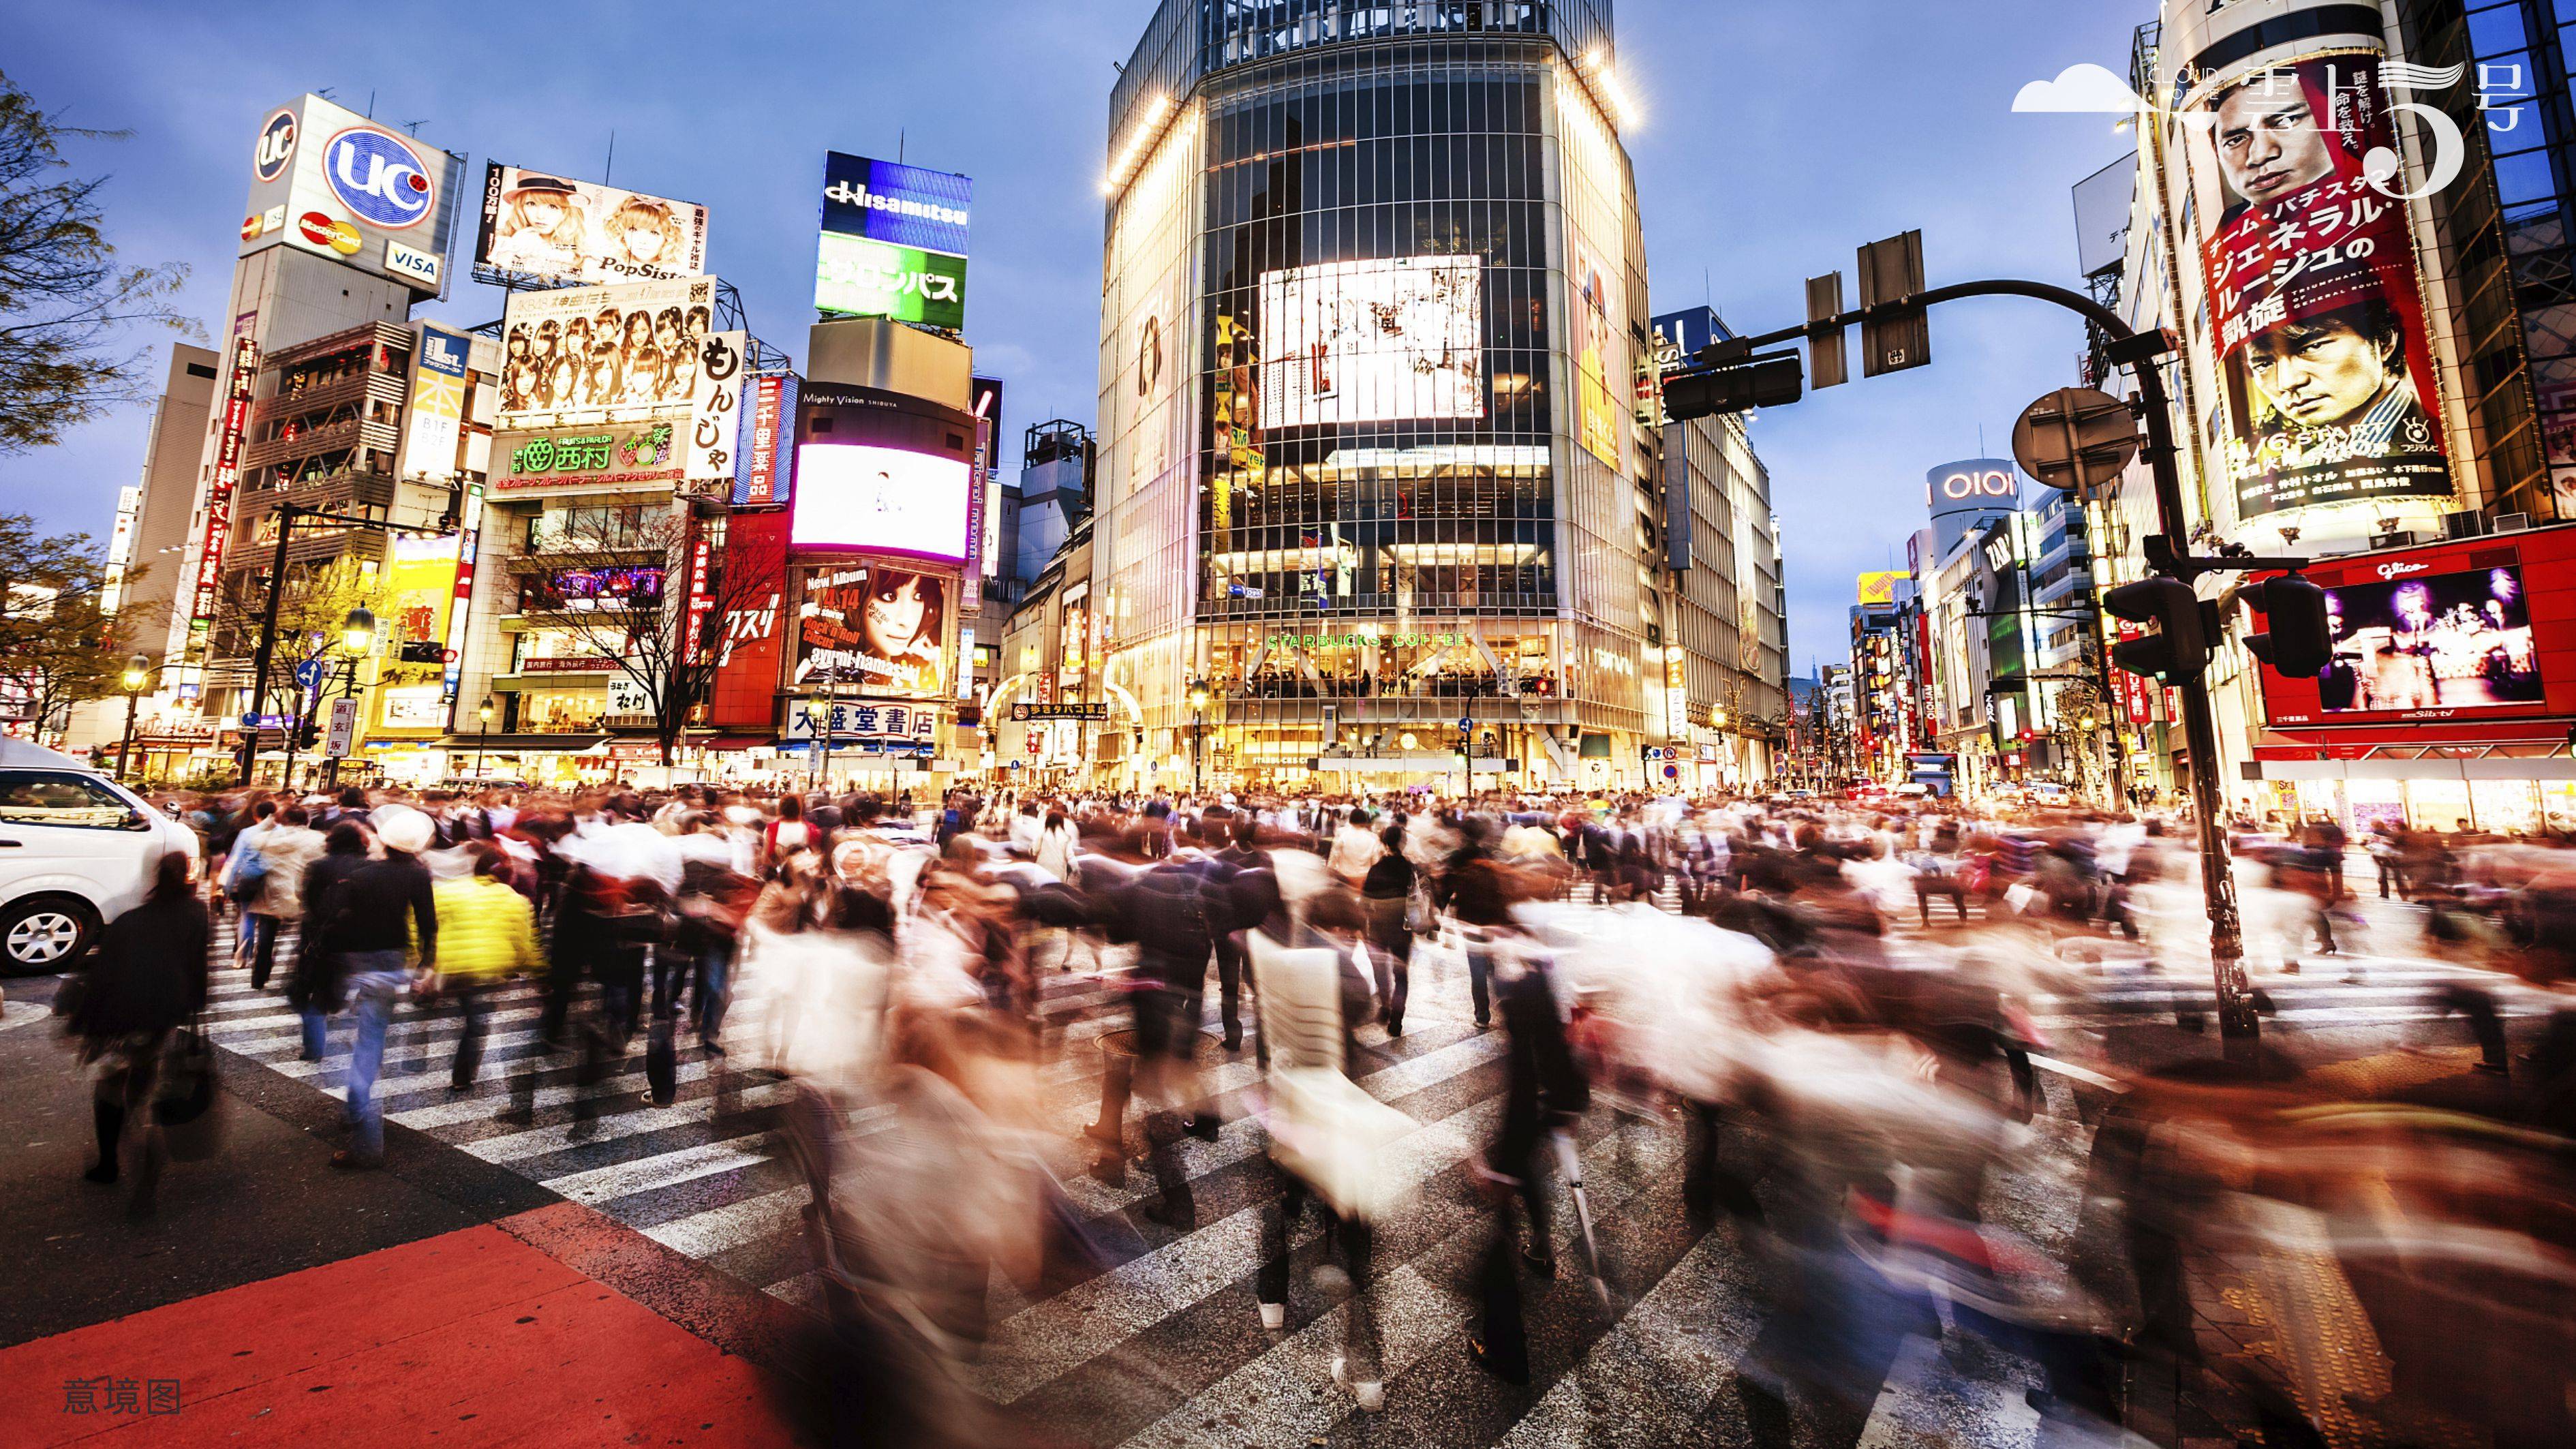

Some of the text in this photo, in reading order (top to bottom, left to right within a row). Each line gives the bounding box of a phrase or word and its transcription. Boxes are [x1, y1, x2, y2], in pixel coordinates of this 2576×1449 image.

[2353, 71, 2376, 128] 謎を解け。
[825, 181, 967, 225] Hisamitsu
[300, 219, 362, 248] MasterCard
[393, 250, 435, 276] VISA
[825, 258, 958, 303] サロンパス
[2217, 237, 2375, 319] ルージュの
[2292, 271, 2363, 295] TRIUMPHANT
[2293, 289, 2346, 309] GENERAL
[2220, 293, 2288, 350] 凱旋
[414, 373, 465, 416] 本
[696, 336, 738, 472] もんじゃ
[803, 393, 835, 405] Mighty
[837, 393, 865, 406] Vision
[748, 382, 776, 495] 三千里薬品
[2400, 444, 2439, 453] フジテレビ
[555, 446, 611, 472] 西村
[807, 569, 868, 591] New Album
[824, 588, 860, 610] 4.14
[1268, 632, 1466, 649] STARBUCKS COFFEE
[616, 692, 647, 710] 松川
[1030, 705, 1107, 716] 歩きタバコ禁止
[1985, 695, 1996, 723] ZARA
[331, 704, 348, 750] 道玄坂
[795, 706, 934, 736] 大盛堂書店
